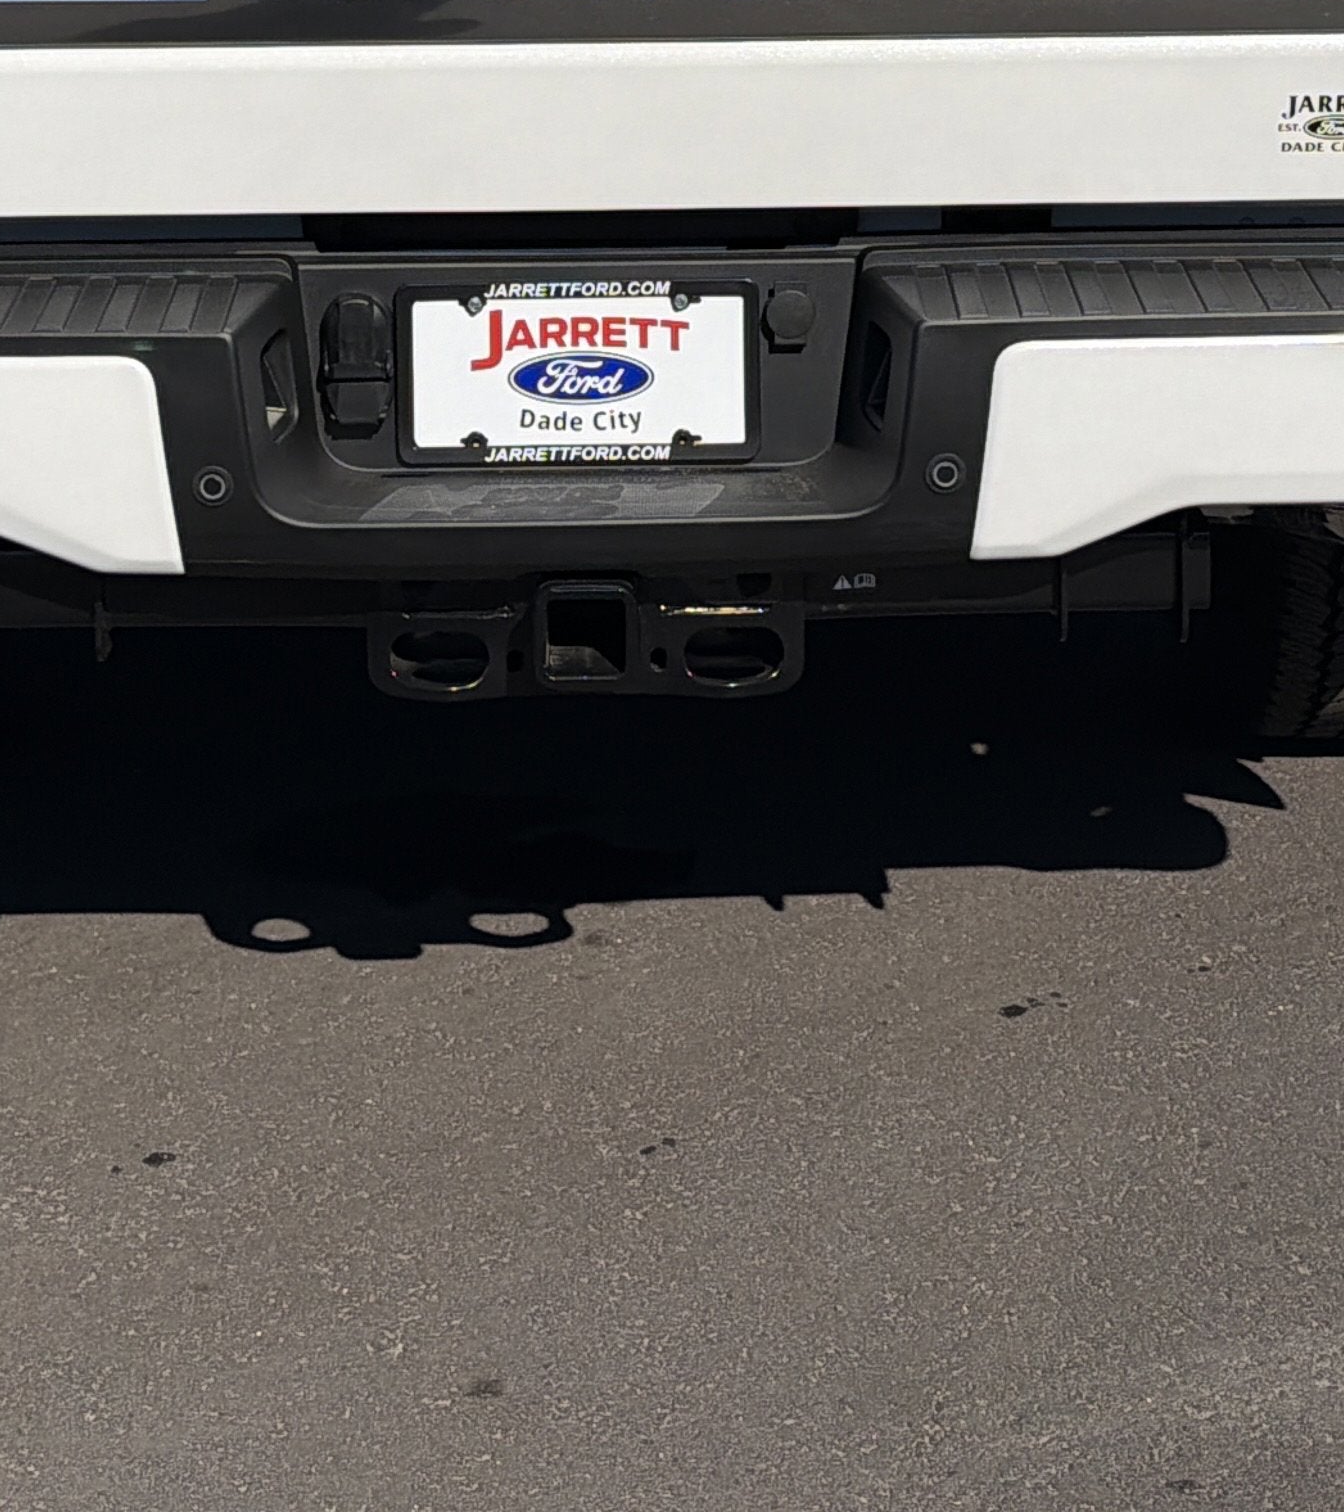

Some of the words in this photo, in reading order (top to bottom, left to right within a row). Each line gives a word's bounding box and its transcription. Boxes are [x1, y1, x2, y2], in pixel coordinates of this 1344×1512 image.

[1281, 141, 1324, 152] DADE
[484, 281, 671, 298] JARRETTFORD.COM
[470, 309, 690, 371] JARRETT
[537, 360, 624, 394] Ford
[520, 409, 583, 431] Dade
[593, 409, 642, 434] City
[484, 445, 671, 464] JARRETTFORD.COM
